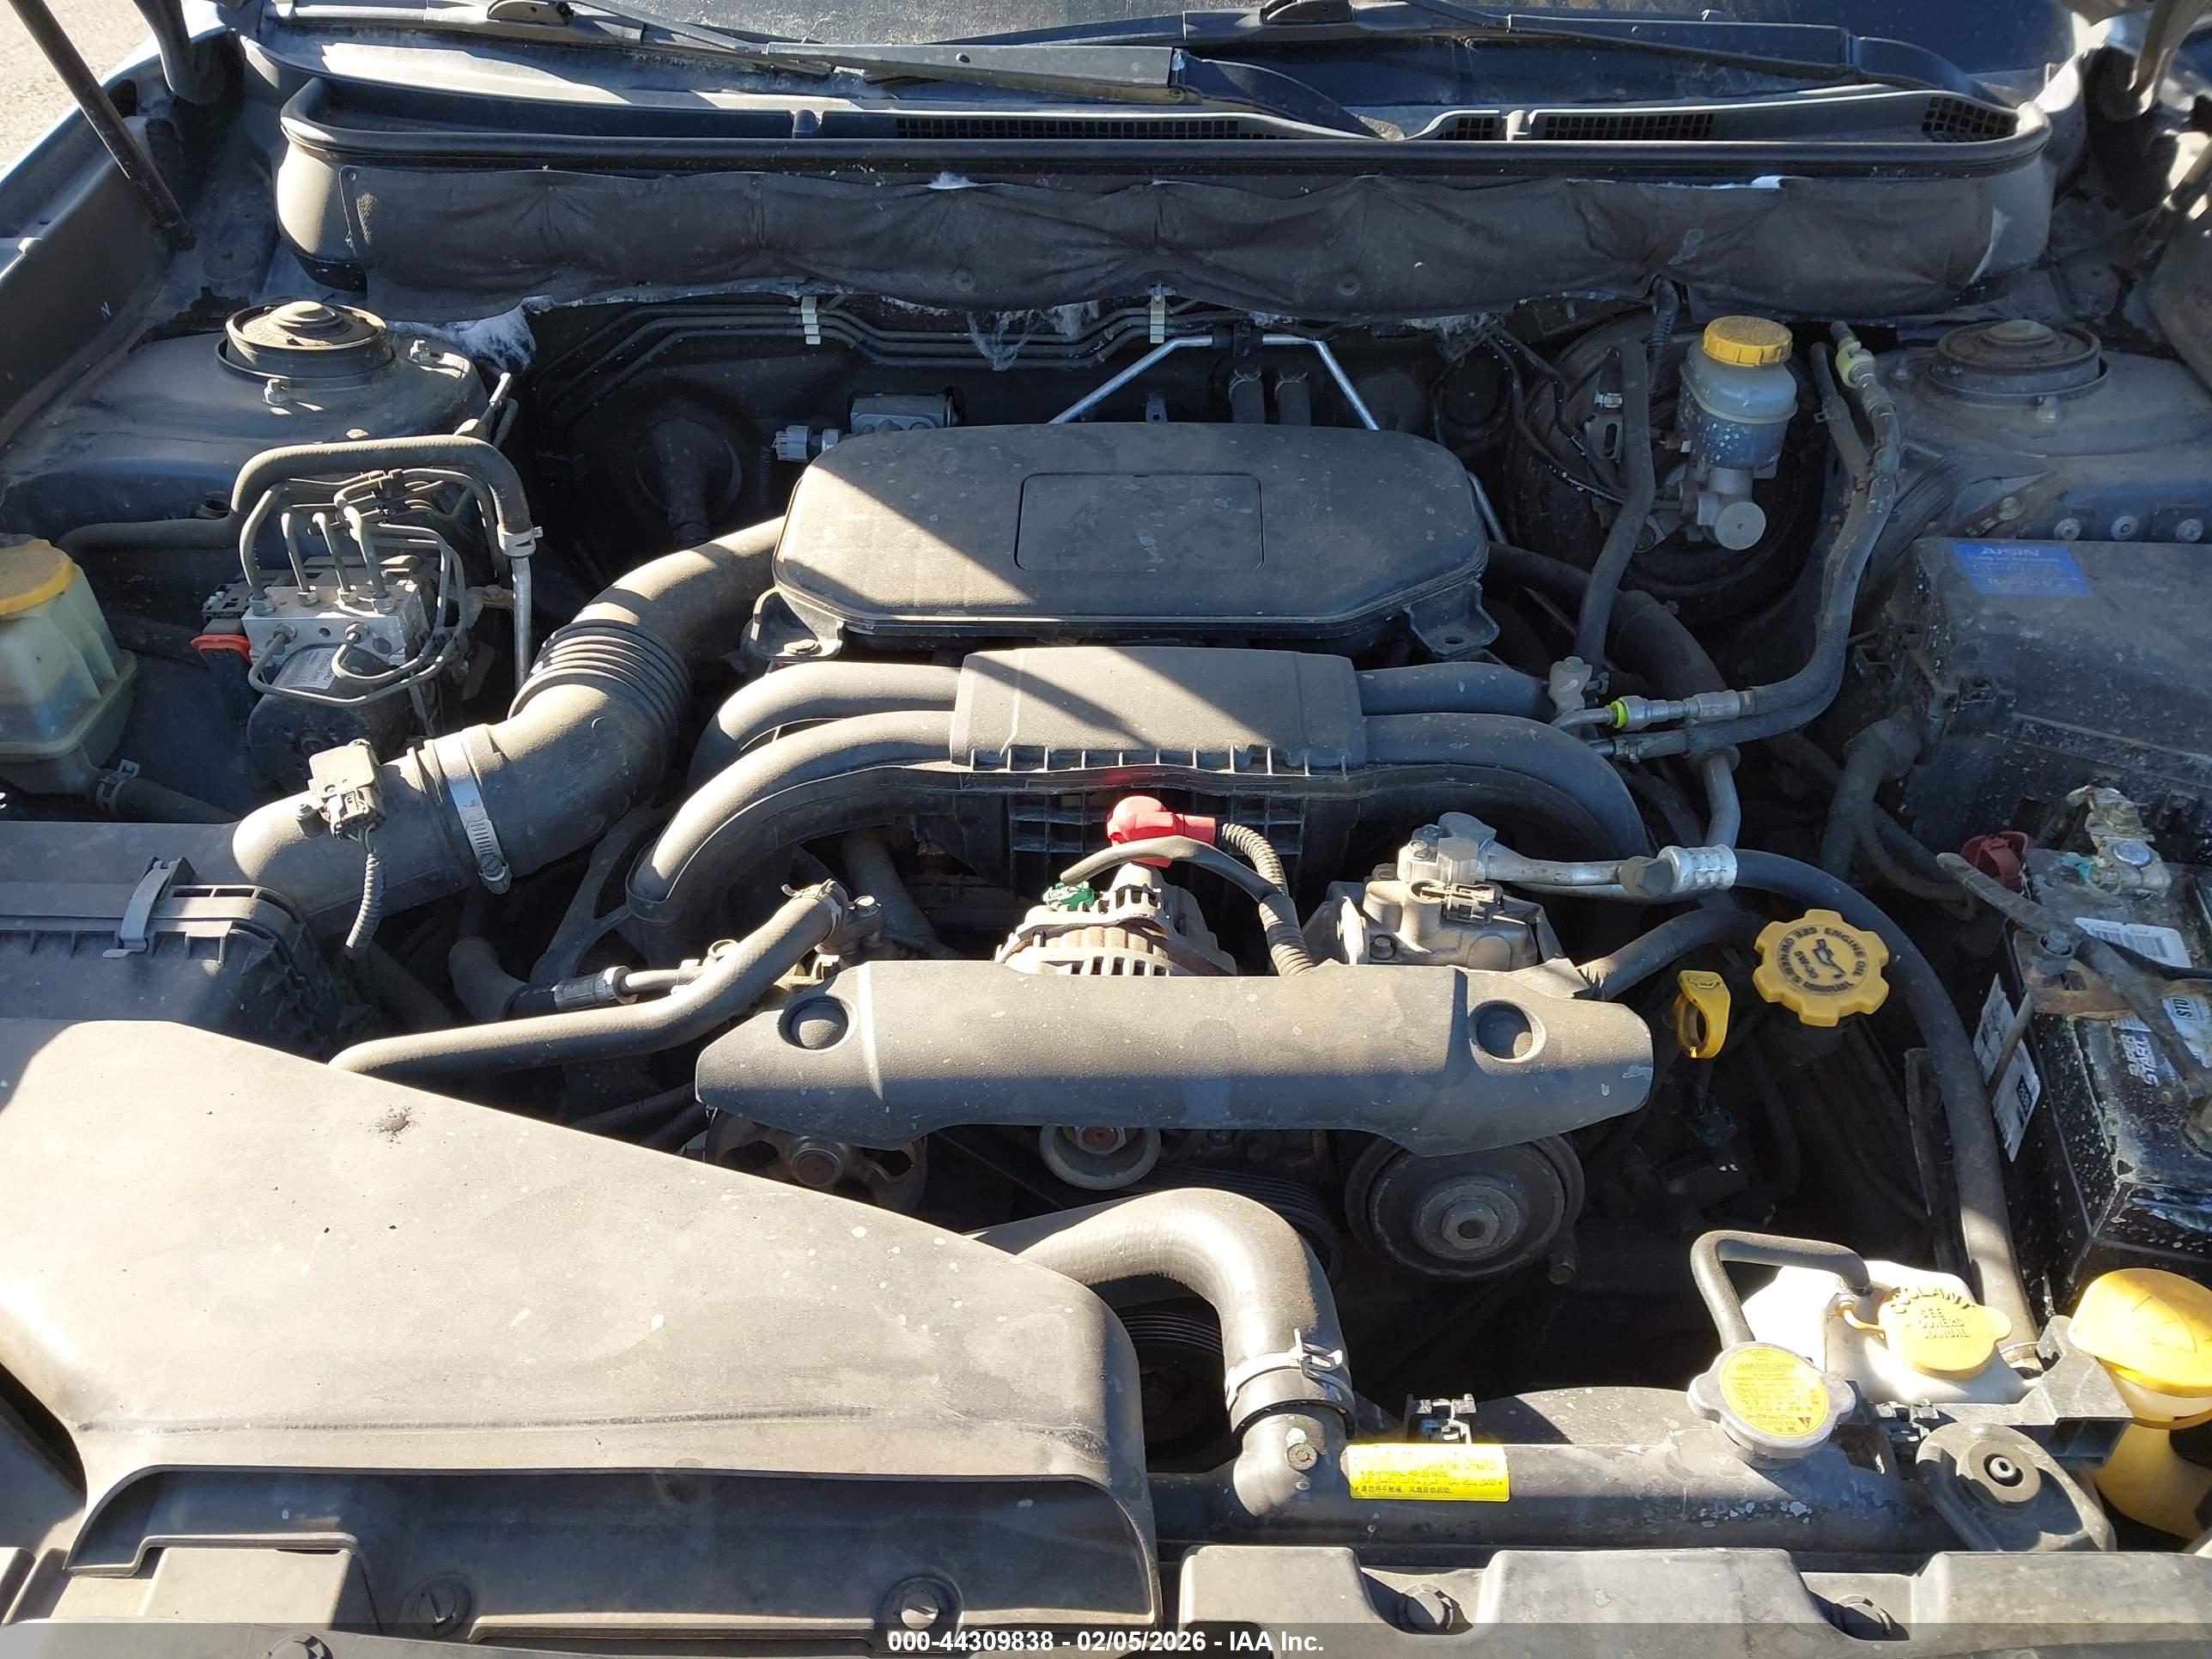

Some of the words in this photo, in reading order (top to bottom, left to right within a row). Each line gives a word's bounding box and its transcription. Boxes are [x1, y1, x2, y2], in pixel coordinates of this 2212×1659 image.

[1981, 547, 2040, 556] AISIN
[1794, 927, 1818, 939] SEE
[1824, 927, 1864, 958] ENGINE
[1852, 960, 1866, 977] OIL
[2119, 1034, 2140, 1077] SUPER
[2133, 1036, 2160, 1087] START
[1890, 1286, 1978, 1314] COOLANT
[1920, 1307, 1945, 1318] SEE
